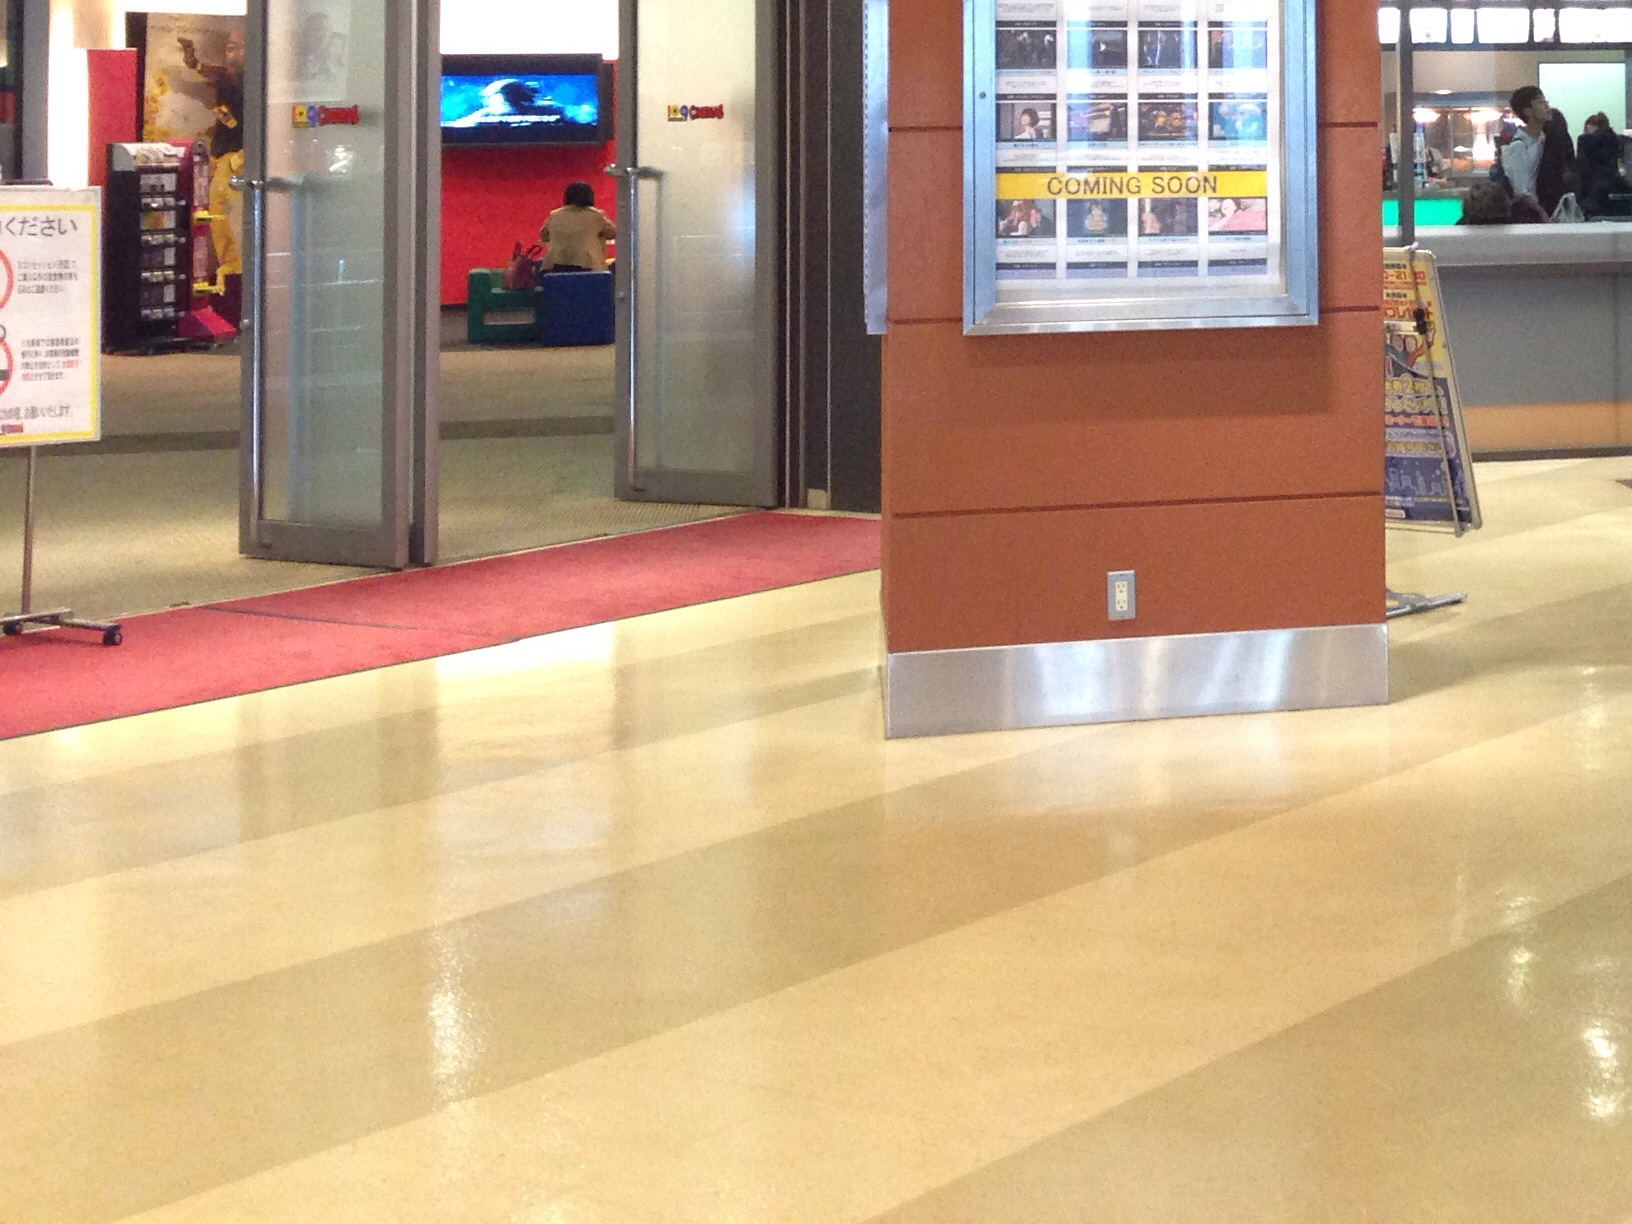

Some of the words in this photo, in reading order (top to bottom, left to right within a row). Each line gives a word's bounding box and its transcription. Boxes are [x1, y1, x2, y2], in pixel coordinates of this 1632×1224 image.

[1047, 176, 1141, 195] COMING
[1151, 176, 1217, 194] SOON
[0, 217, 78, 237] ください
